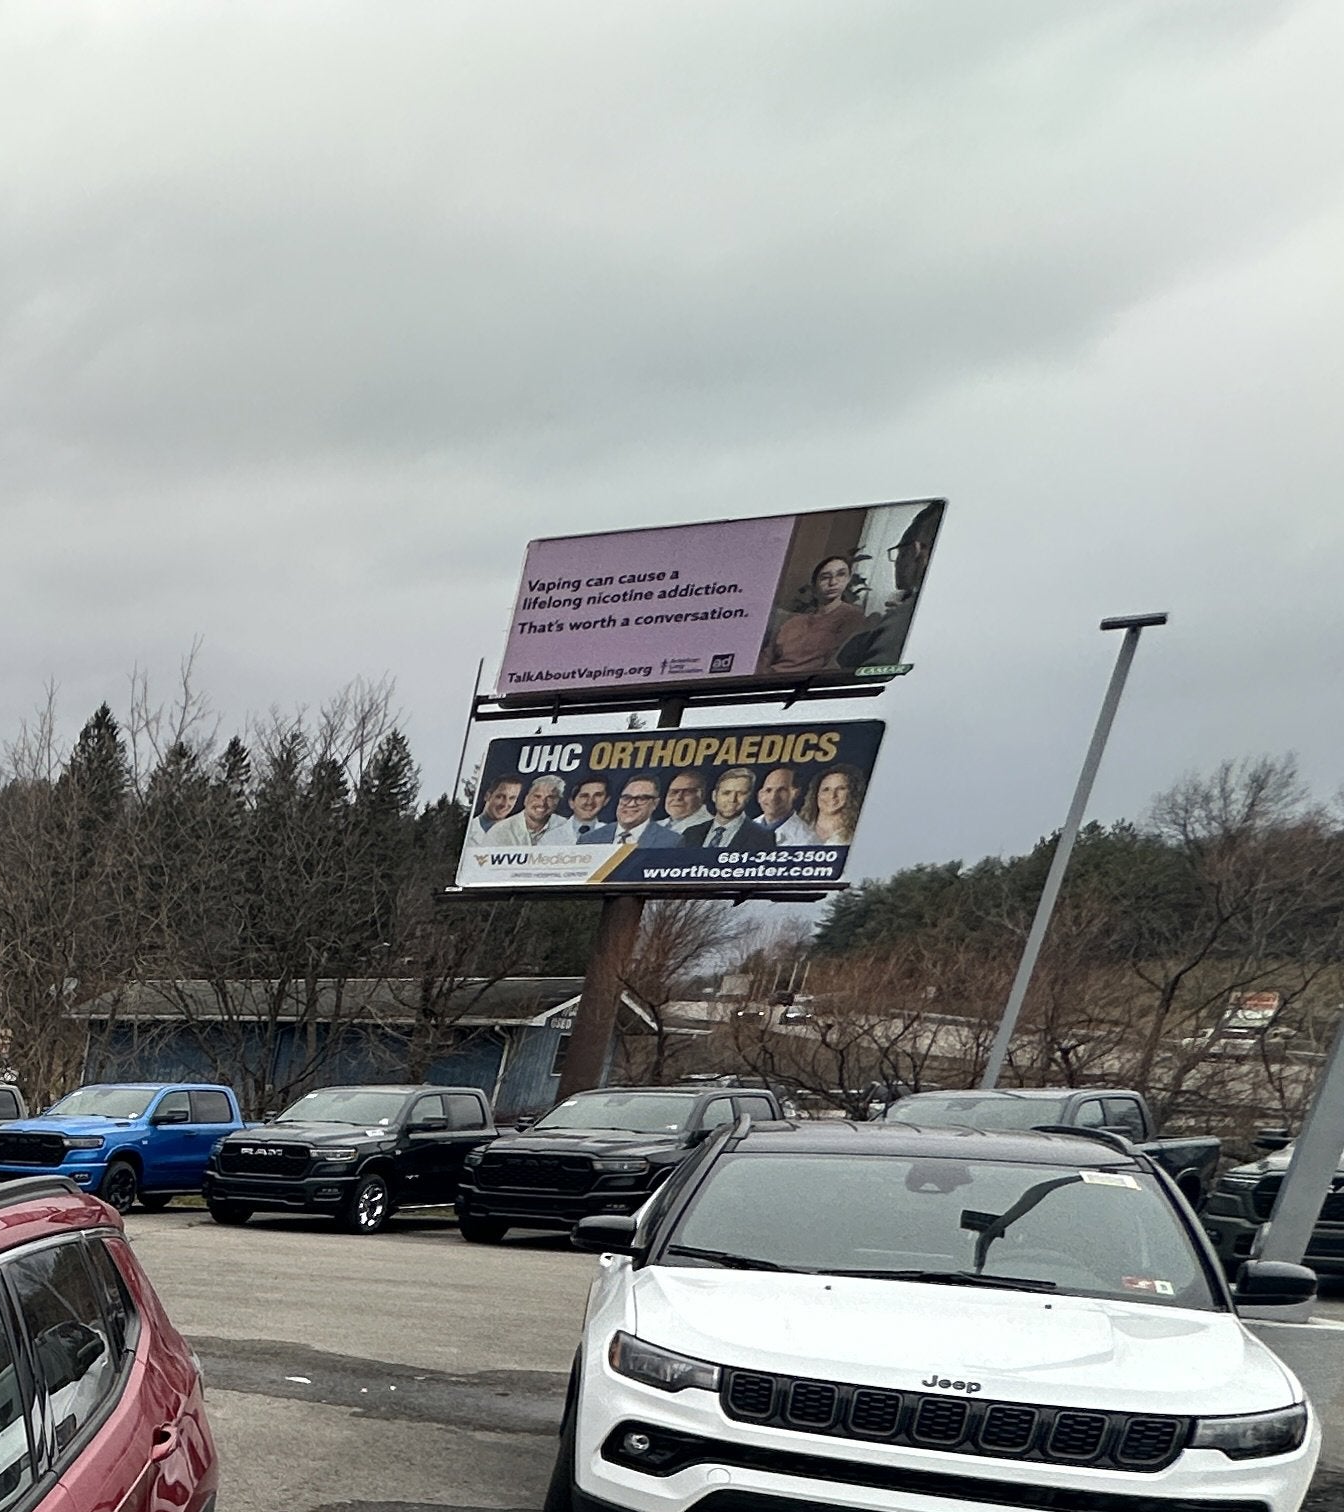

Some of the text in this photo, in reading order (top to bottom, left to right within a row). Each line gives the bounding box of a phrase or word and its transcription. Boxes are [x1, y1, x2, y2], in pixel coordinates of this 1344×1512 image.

[528, 570, 680, 594] Vaping can cause a
[522, 582, 744, 611] lifelong nicotine addiction.
[518, 607, 750, 635] That's worth a conversation.
[508, 664, 653, 684] TalkAboutVaping.org
[518, 732, 841, 774] UHC ORTHOPAEDICS
[718, 850, 838, 865] 681-342-3500
[643, 864, 833, 879] wvorthocenter.com
[240, 1147, 283, 1157] RAM
[921, 1374, 982, 1394] Jeep
